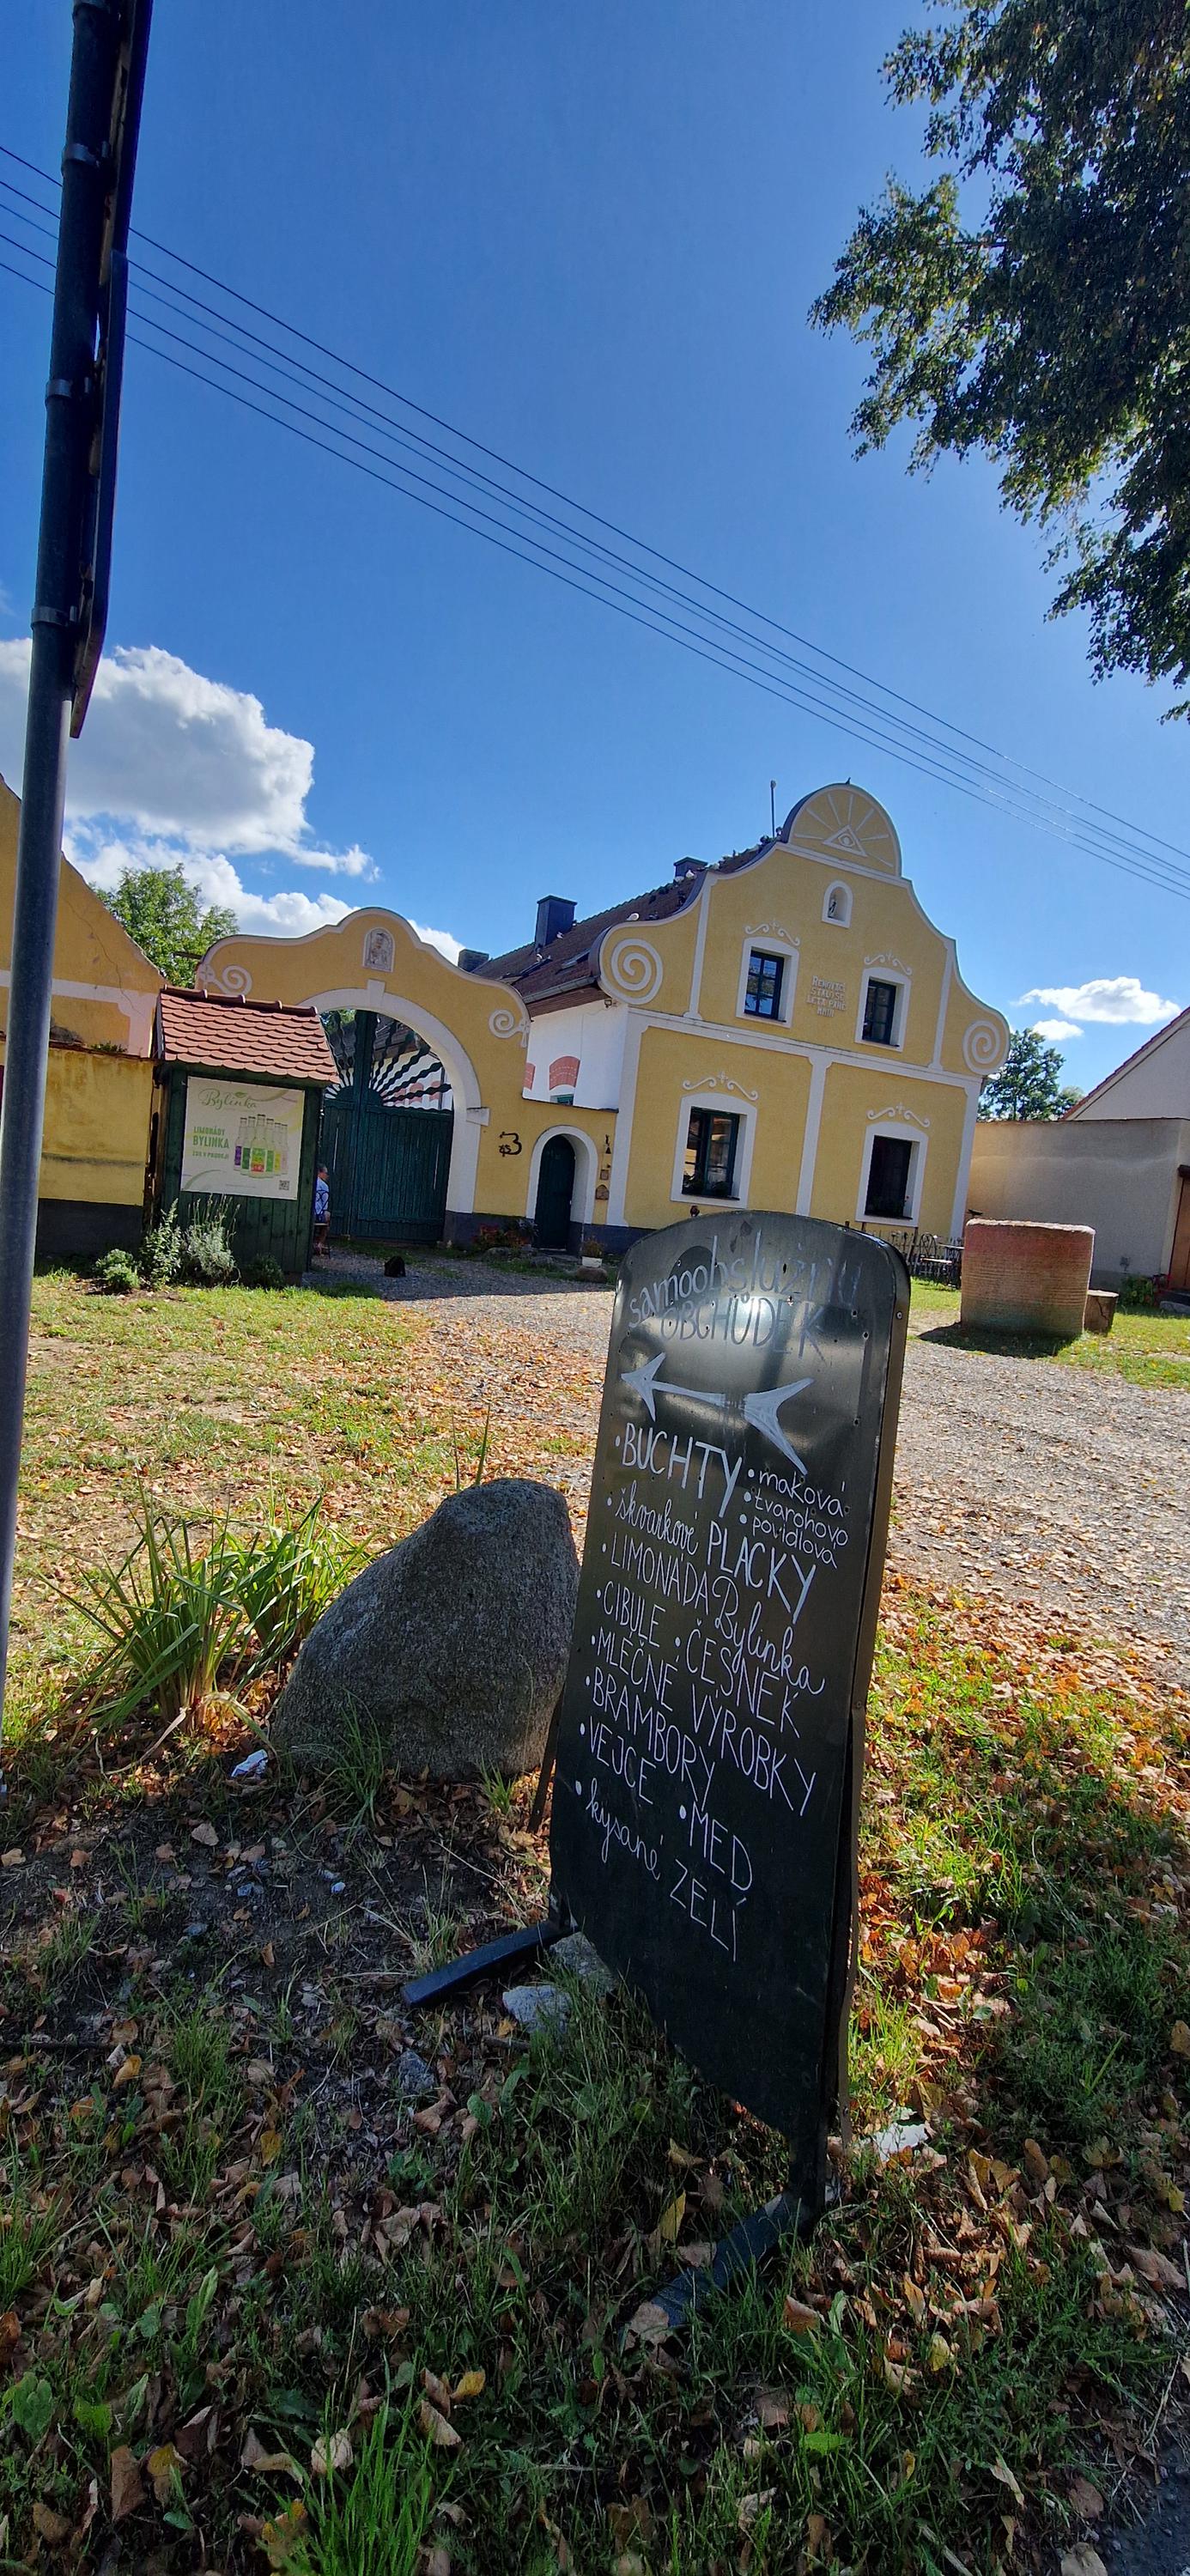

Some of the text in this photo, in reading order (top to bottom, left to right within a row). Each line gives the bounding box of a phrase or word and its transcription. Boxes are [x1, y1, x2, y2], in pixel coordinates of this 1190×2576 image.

[192, 1134, 229, 1149] BYLINKA
[198, 1088, 257, 1110] Bylinka
[622, 1423, 742, 1518] BUCHTY
[759, 1471, 846, 1518] maková
[611, 1532, 825, 1695] LIMONÁDA Bylinka
[615, 1479, 816, 1625] škvarkové PLACKY
[598, 1625, 816, 1816] MLÉČNÉ VÝROBKY
[604, 1581, 800, 1738] CIBULE ČESNEK
[590, 1716, 752, 1891] VEJCE MED
[593, 1667, 715, 1812] BRAMBORY
[586, 1777, 746, 1962] kysané ZELÍ
